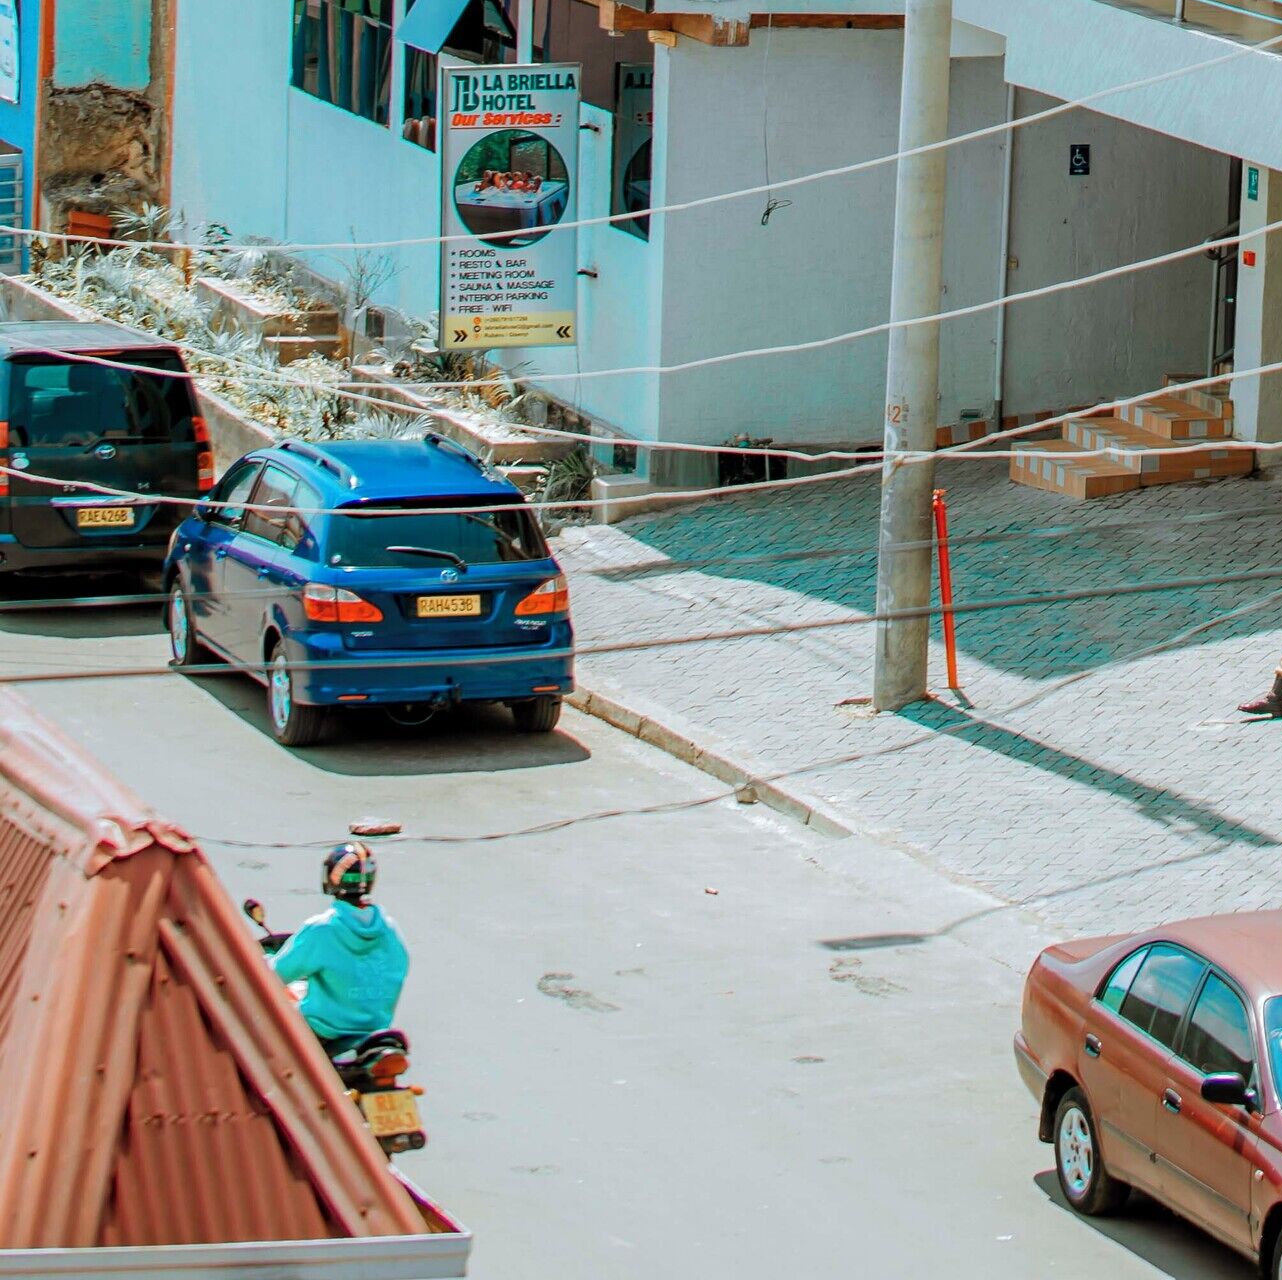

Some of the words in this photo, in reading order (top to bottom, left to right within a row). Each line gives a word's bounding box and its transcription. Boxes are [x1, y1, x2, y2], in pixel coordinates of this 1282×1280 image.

[483, 75, 504, 91] LA
[507, 73, 577, 90] BRIELLA
[482, 93, 536, 111] HOTEL
[451, 113, 480, 126] Our
[482, 111, 552, 126] Services
[459, 249, 496, 258] ROOMS
[459, 260, 492, 269] RESTO
[506, 259, 527, 268] BAR
[459, 270, 502, 280] MEETING
[505, 270, 535, 279] ROOM
[459, 282, 492, 291] SAUNA
[506, 280, 555, 289] MASSAGE
[459, 293, 503, 302] INTERIOR
[506, 292, 549, 301] PARKING
[458, 304, 484, 314] FREE
[492, 303, 513, 312] WIFI
[79, 510, 128, 523] RAE426B
[420, 597, 474, 612] RAH453B
